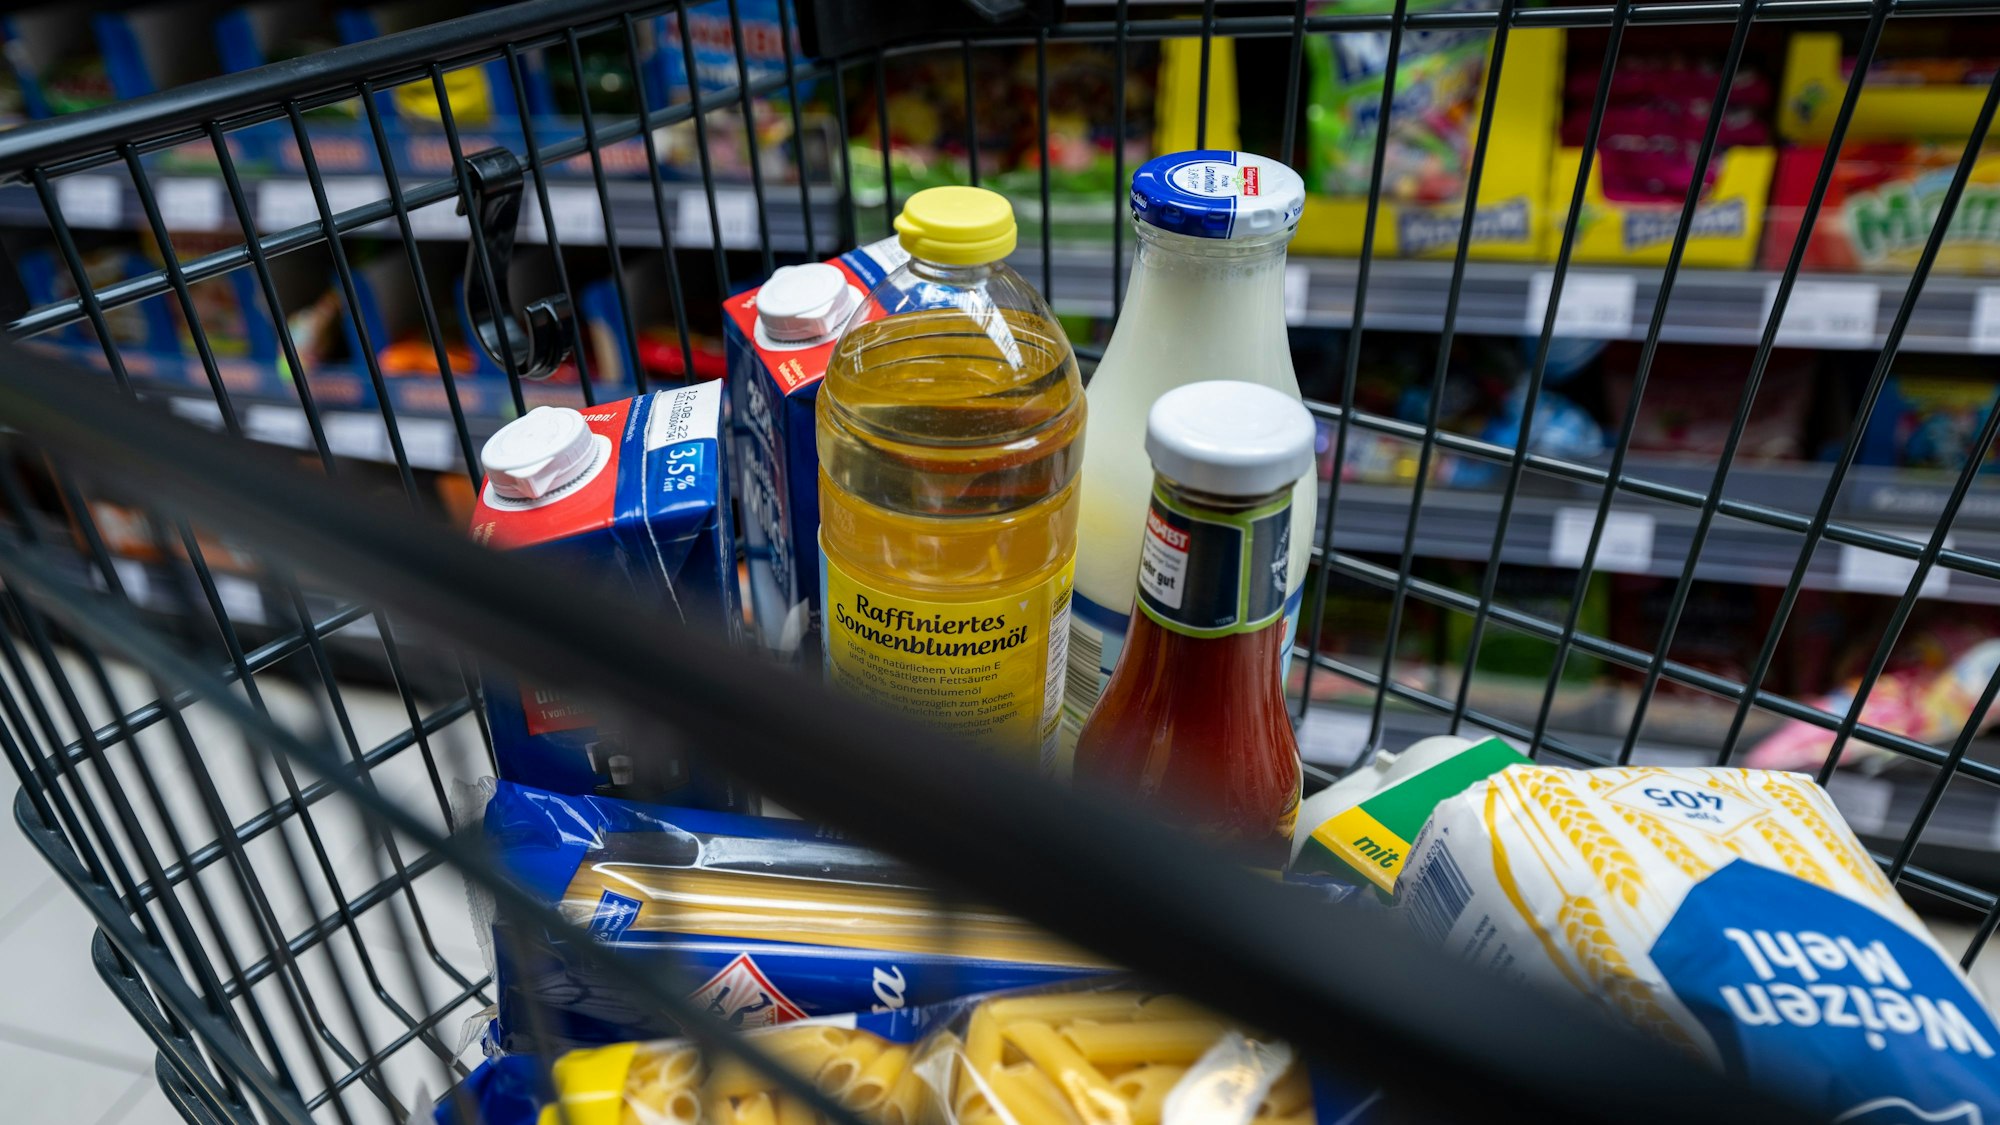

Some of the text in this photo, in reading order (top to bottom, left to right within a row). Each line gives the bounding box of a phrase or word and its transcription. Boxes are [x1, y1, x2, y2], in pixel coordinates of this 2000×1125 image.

[1204, 166, 1217, 193] Landmilch
[677, 390, 698, 440] 12.08.22
[666, 447, 697, 491] 3,5%
[1157, 571, 1176, 591] gut
[836, 602, 1029, 658] Sonnenblumenöl
[855, 593, 1006, 635] Raffiniertes
[847, 640, 1001, 675] reich an natürlichem Vitamin E
[849, 651, 998, 685] und ungesättigten Fettsäuren
[889, 680, 982, 697] Sonnenblumenöl
[910, 698, 957, 710] vorzüglich
[959, 700, 979, 708] zum
[902, 705, 952, 717] Anrichten
[955, 710, 974, 718] von
[1643, 788, 1723, 811] 405
[1353, 836, 1399, 869] mit
[1722, 927, 1912, 990] Mehl
[1719, 981, 1996, 1059] Weizen
